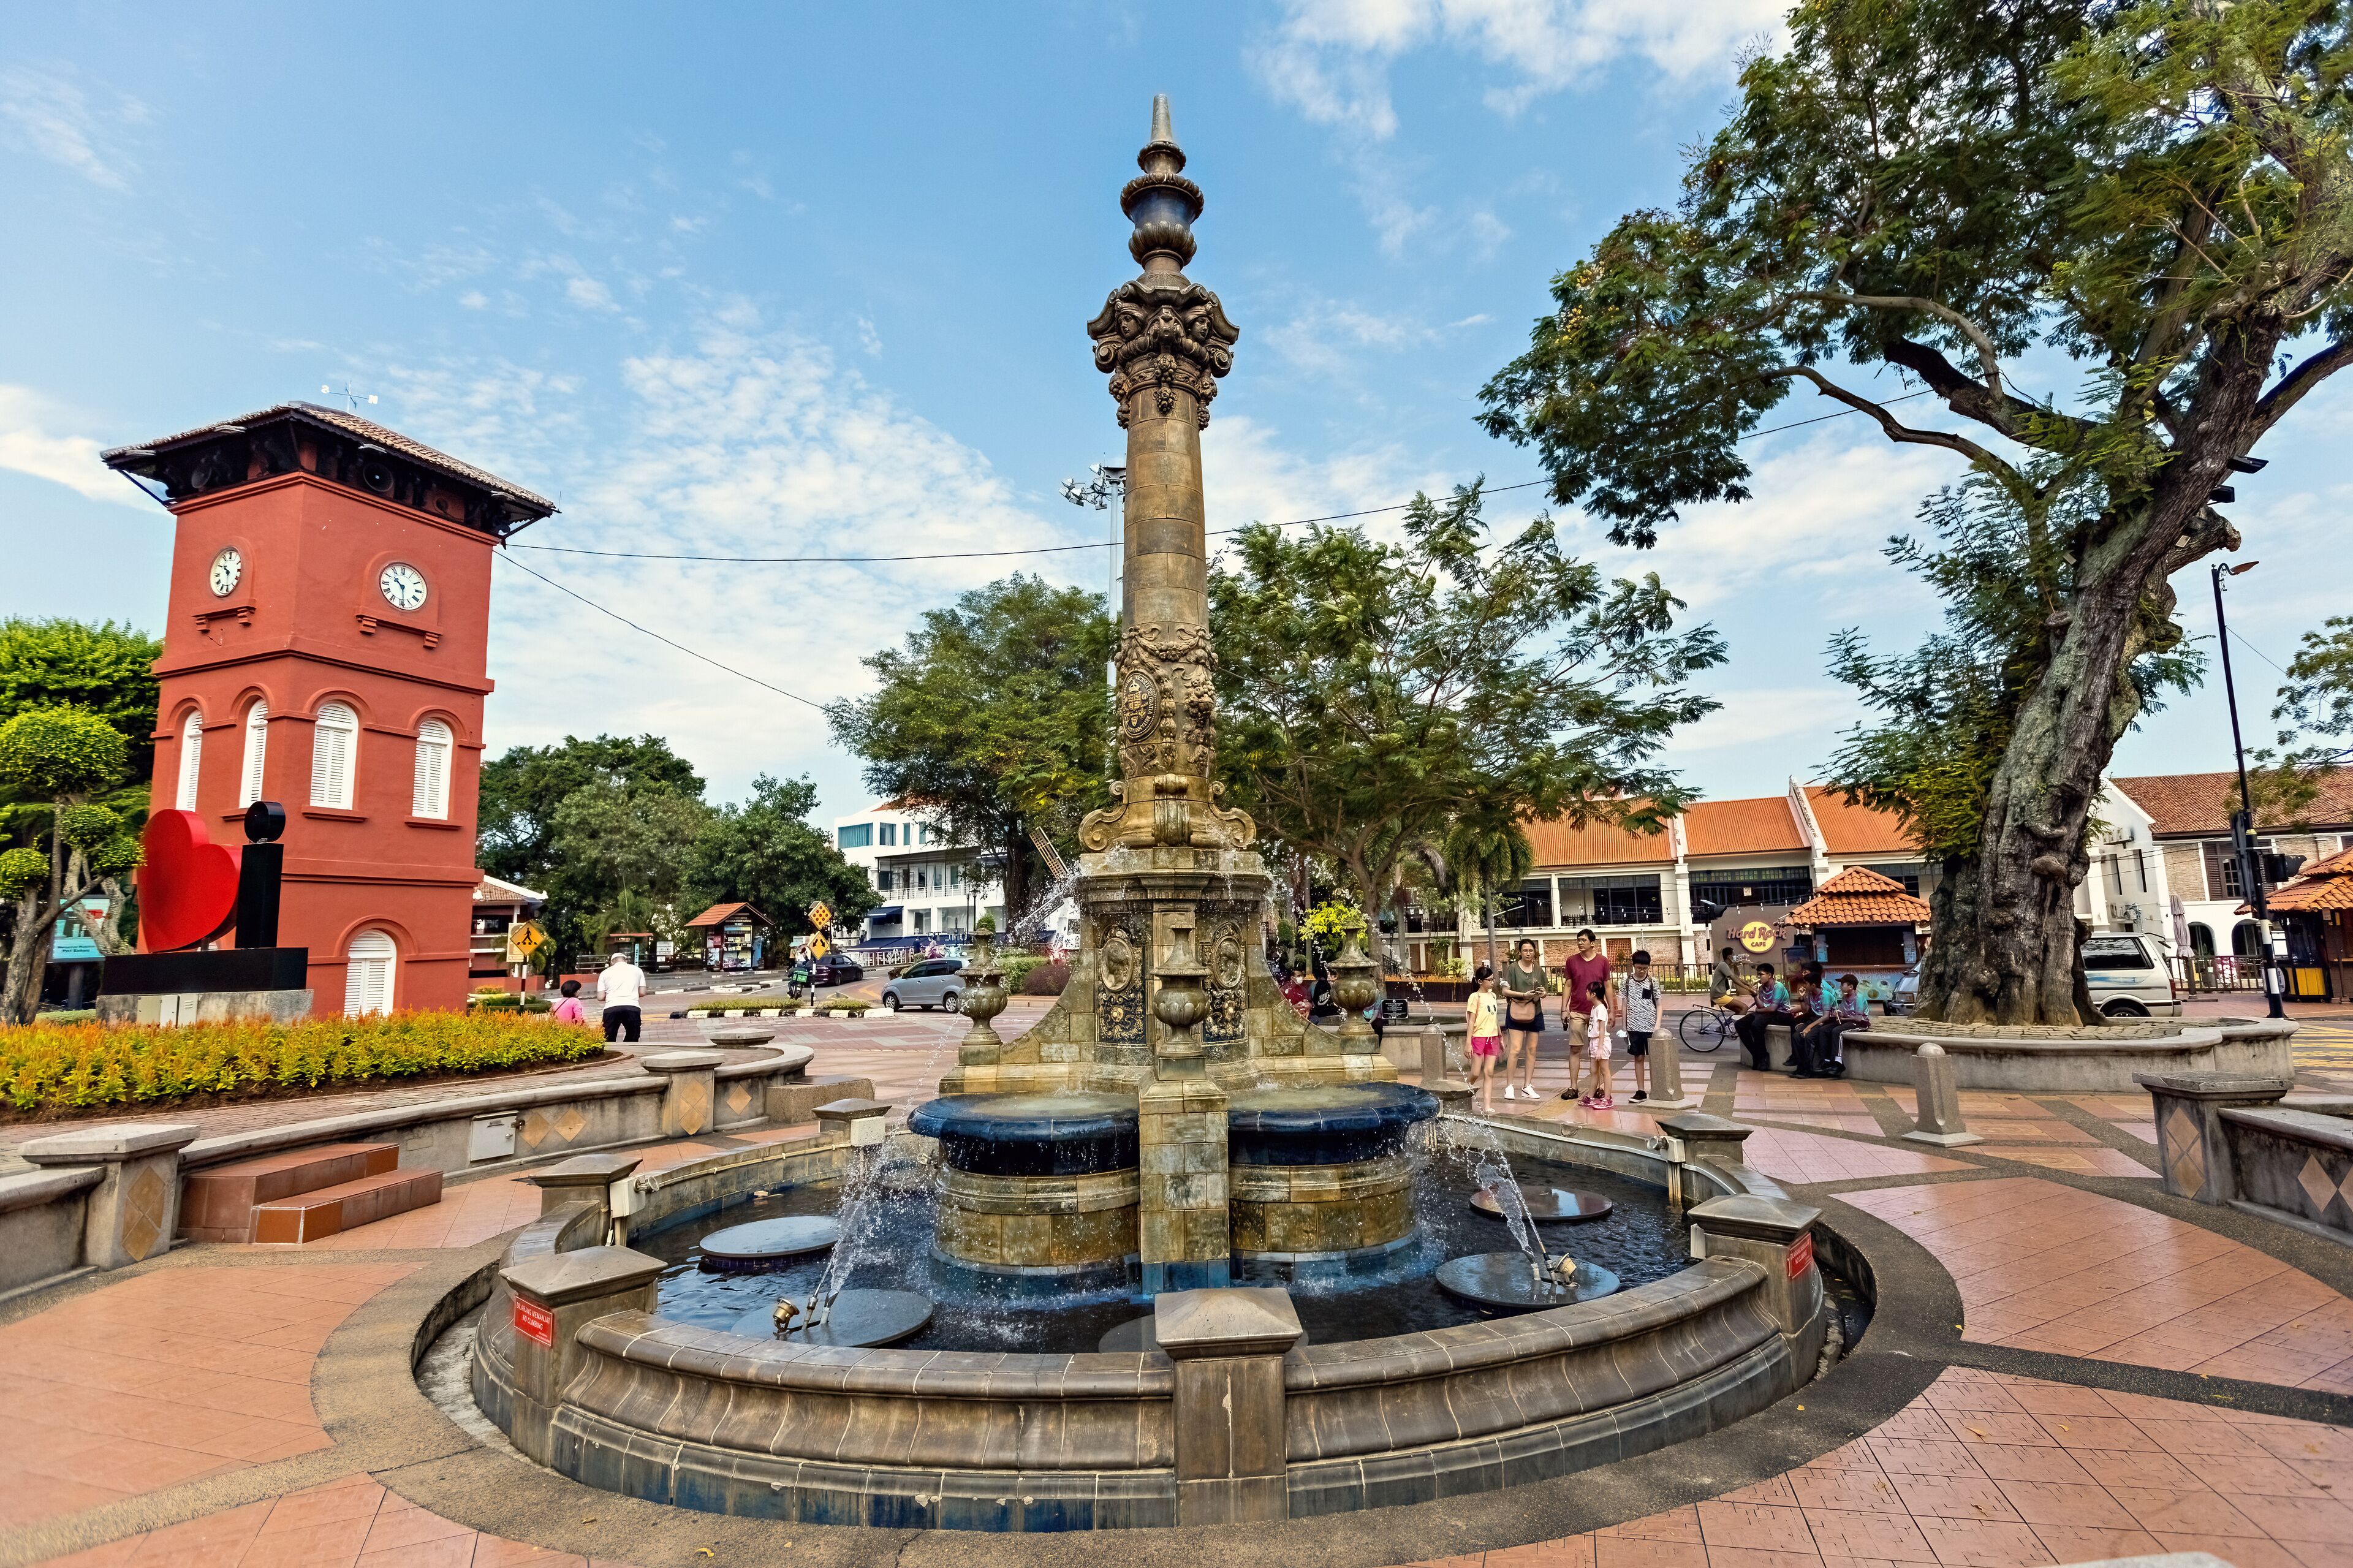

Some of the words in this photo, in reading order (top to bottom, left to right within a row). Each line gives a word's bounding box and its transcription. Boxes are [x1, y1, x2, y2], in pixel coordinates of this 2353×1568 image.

[1727, 926, 1757, 940] Hard
[1758, 926, 1787, 941] Rock
[516, 1301, 532, 1316] DILARANG
[532, 1311, 550, 1324] MEMANJAT
[528, 1317, 544, 1330] CLIMBING
